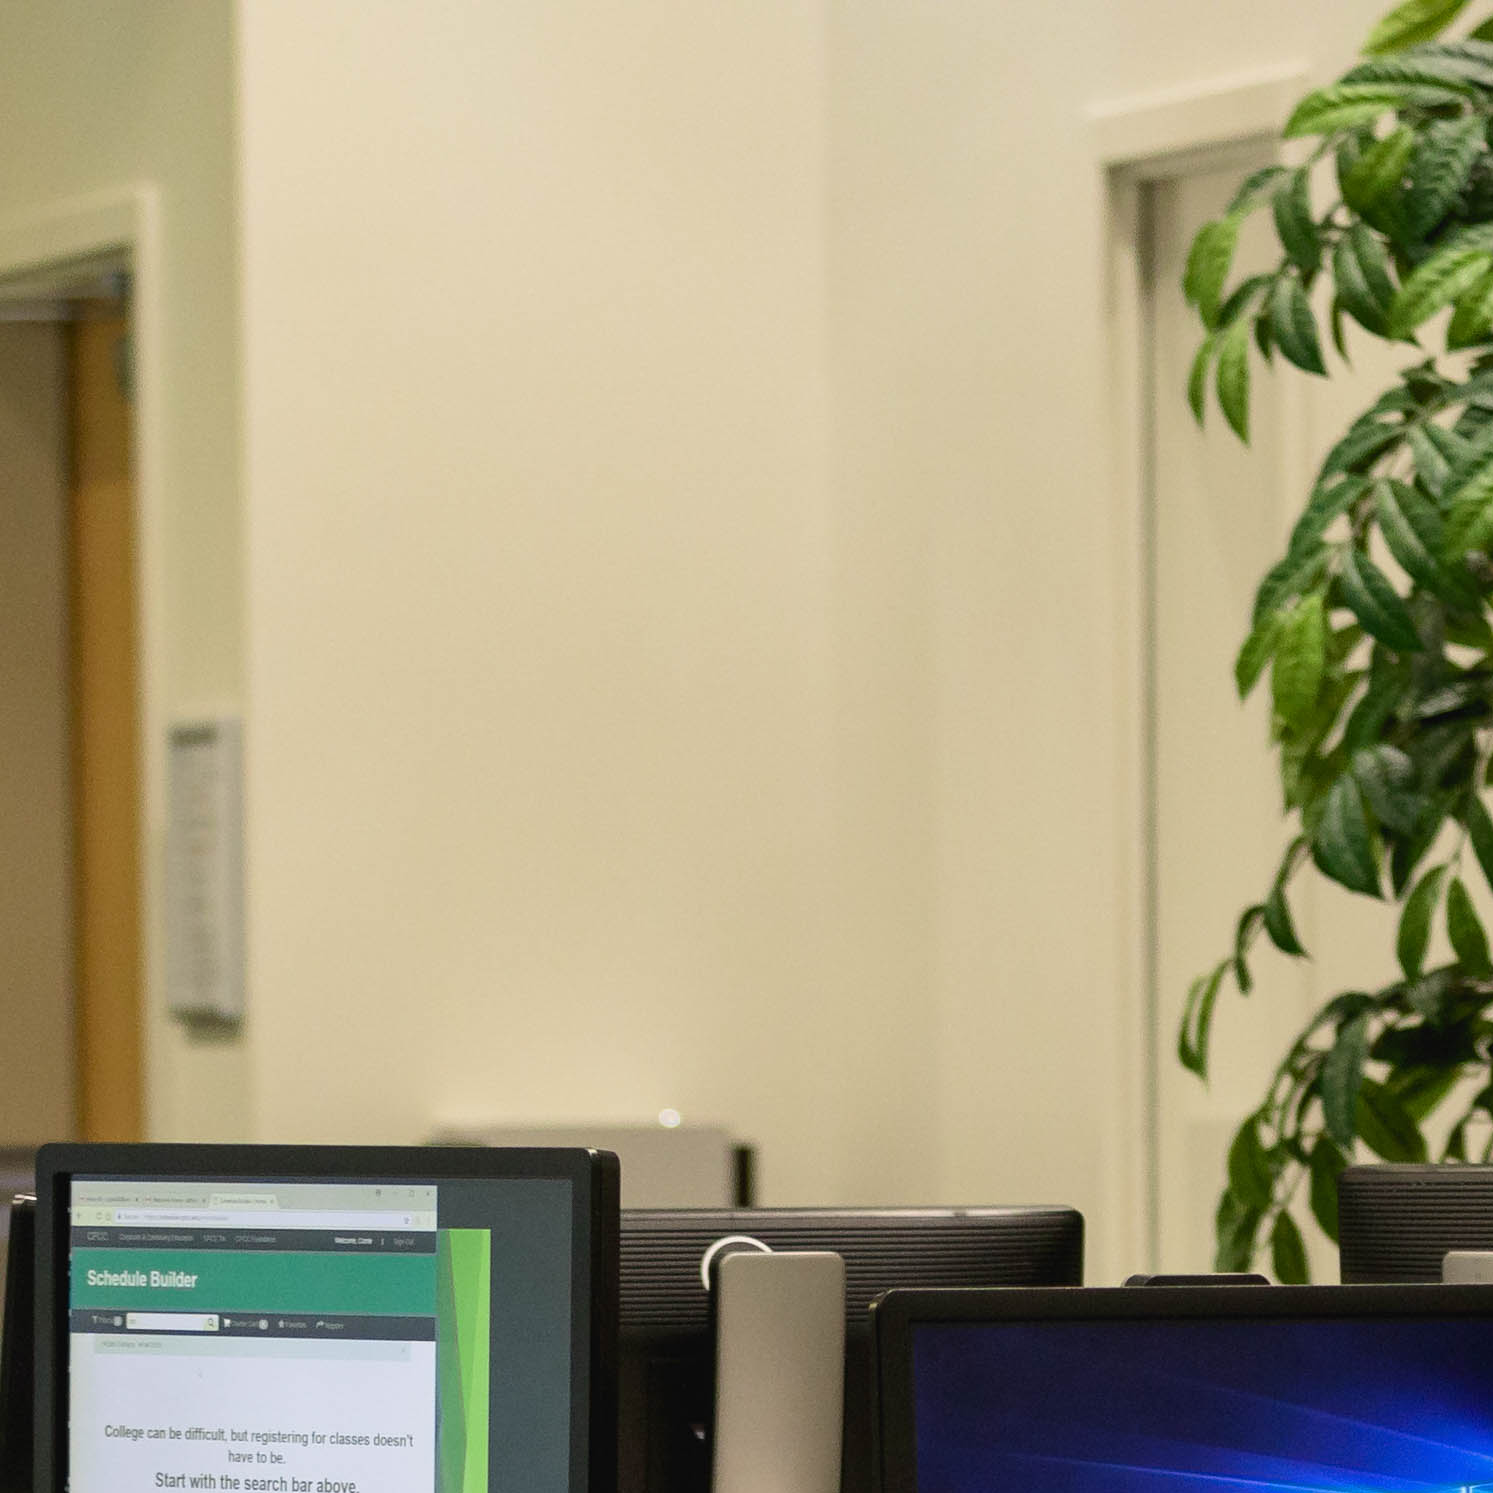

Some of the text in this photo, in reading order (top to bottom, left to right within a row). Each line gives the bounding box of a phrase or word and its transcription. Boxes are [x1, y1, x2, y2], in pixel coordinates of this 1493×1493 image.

[87, 1269, 198, 1288] Schedule Builder
[104, 1425, 413, 1447] College can be difficult, but registering for classes doesn't
[228, 1450, 286, 1464] have to be.
[155, 1472, 360, 1493] Start with the search bar above.
